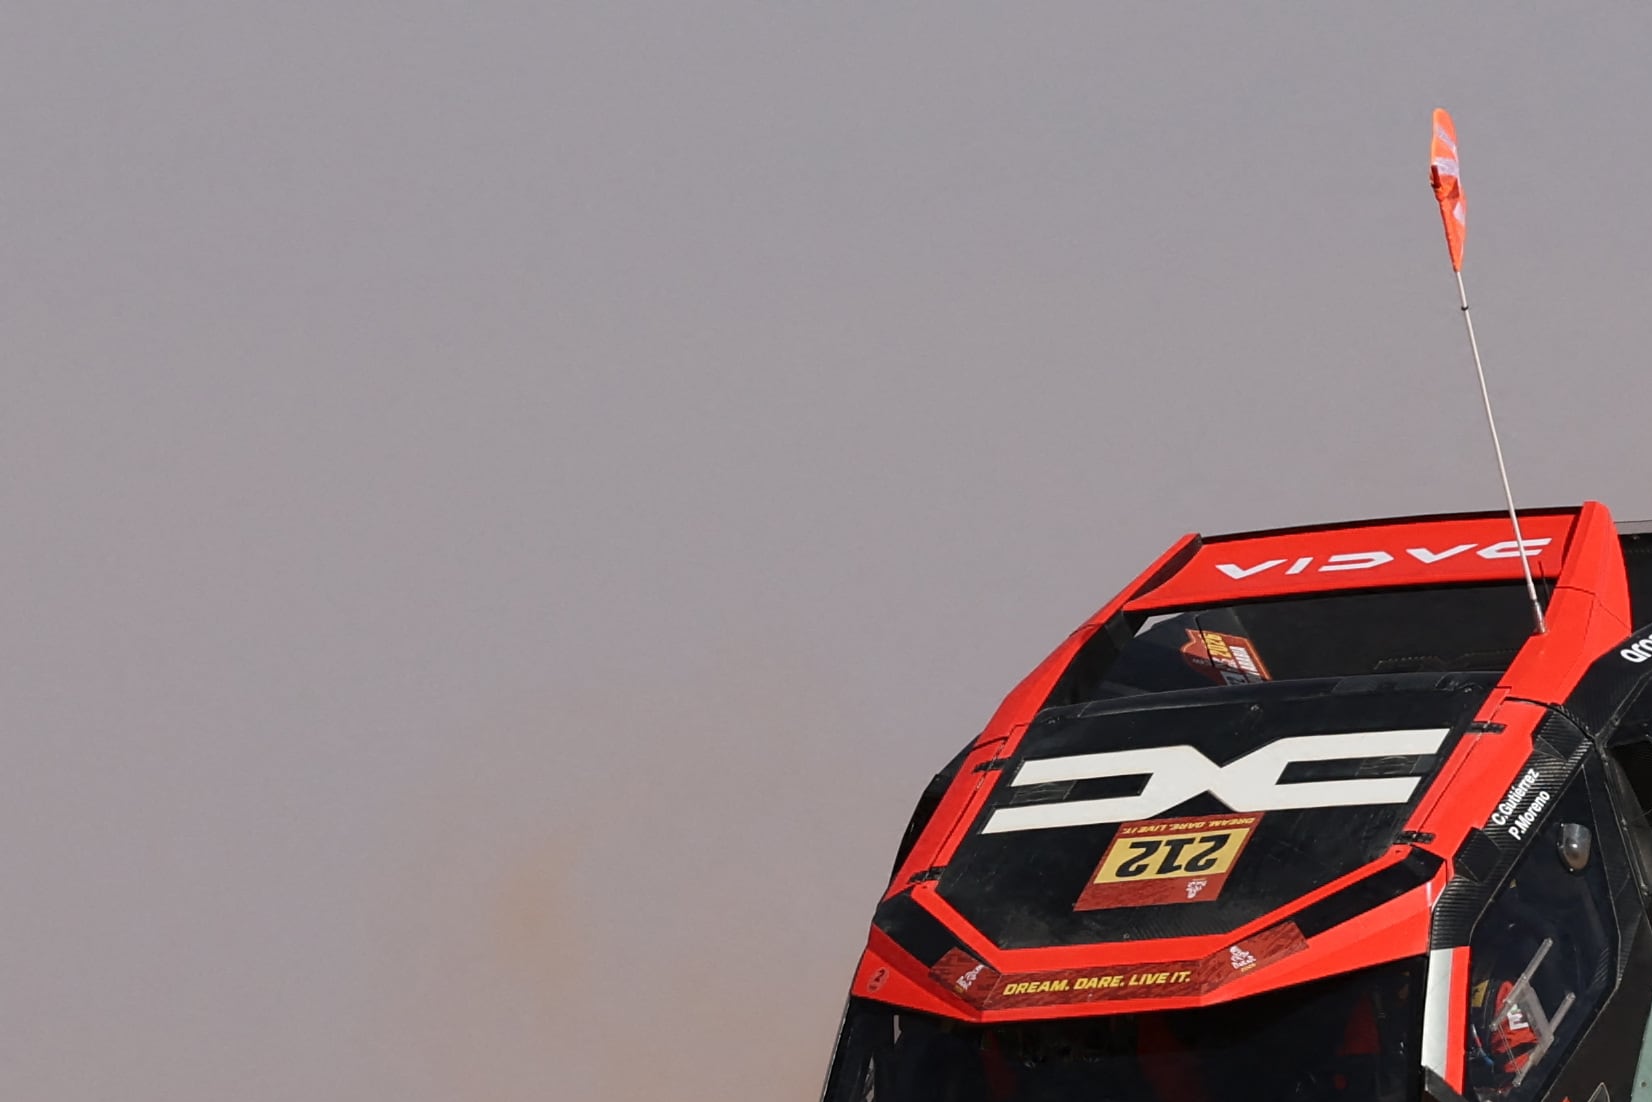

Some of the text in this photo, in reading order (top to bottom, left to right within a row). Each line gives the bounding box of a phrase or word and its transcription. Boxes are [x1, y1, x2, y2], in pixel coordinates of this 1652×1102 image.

[1214, 537, 1553, 581] DACIA
[1491, 768, 1540, 826] C.Gutiérrez
[1508, 790, 1551, 841] P.Moreno
[1138, 823, 1168, 834] LIVE
[1115, 833, 1232, 877] 212
[1003, 971, 1191, 995] DREAM. DARE. LIVE IT.
